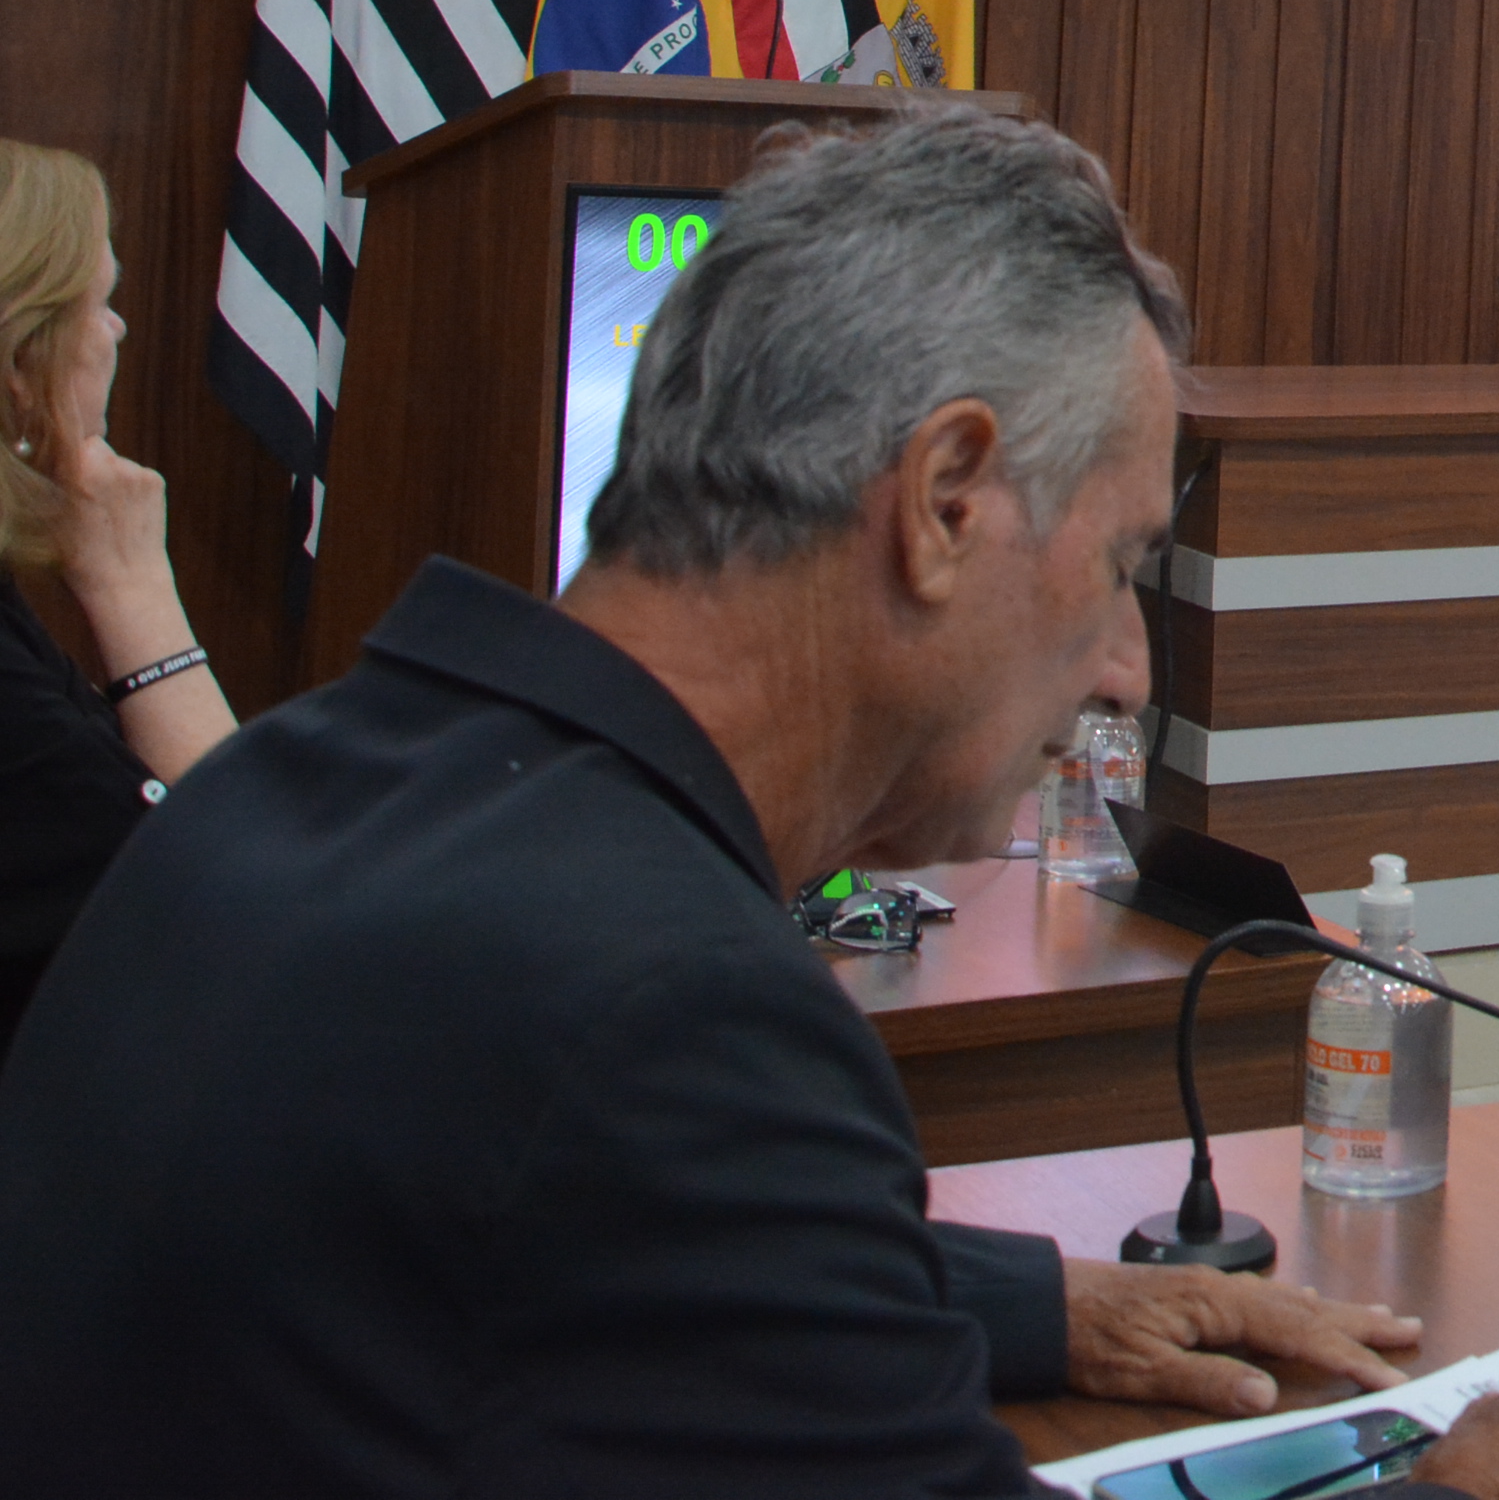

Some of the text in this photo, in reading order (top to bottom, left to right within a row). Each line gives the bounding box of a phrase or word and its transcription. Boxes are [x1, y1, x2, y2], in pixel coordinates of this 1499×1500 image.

[137, 666, 161, 685] QUE
[163, 654, 190, 674] JESUS
[1328, 1050, 1356, 1070] GEL
[1360, 1053, 1382, 1072] 70
